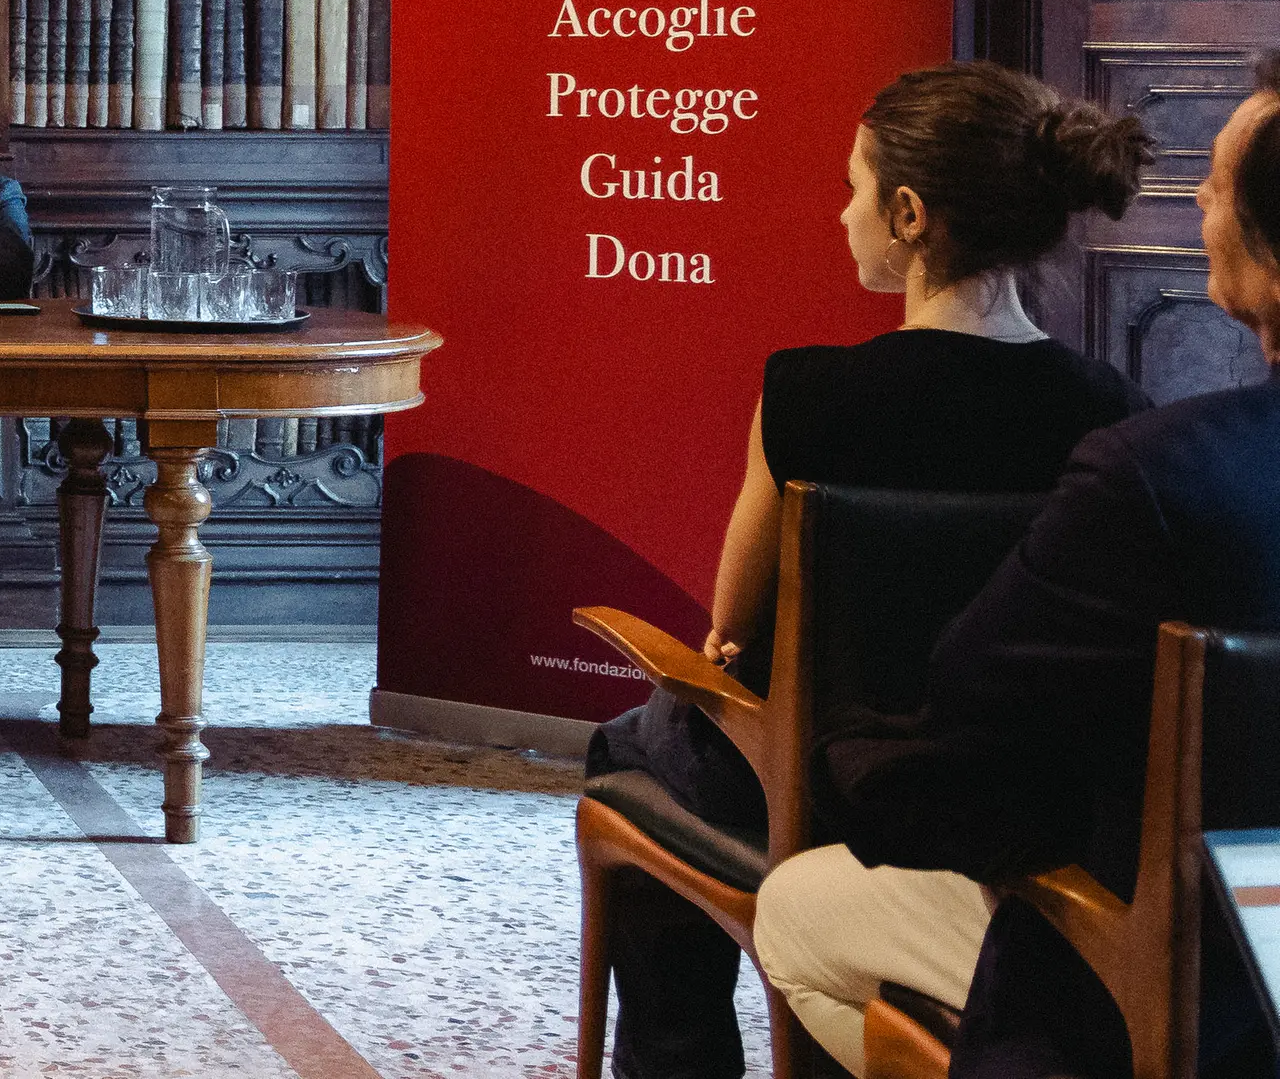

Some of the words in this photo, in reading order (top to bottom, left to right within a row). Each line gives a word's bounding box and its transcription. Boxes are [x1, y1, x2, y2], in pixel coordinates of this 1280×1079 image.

[546, 72, 759, 135] Protegge
[580, 152, 723, 202] Guida
[585, 233, 716, 284] Dona
